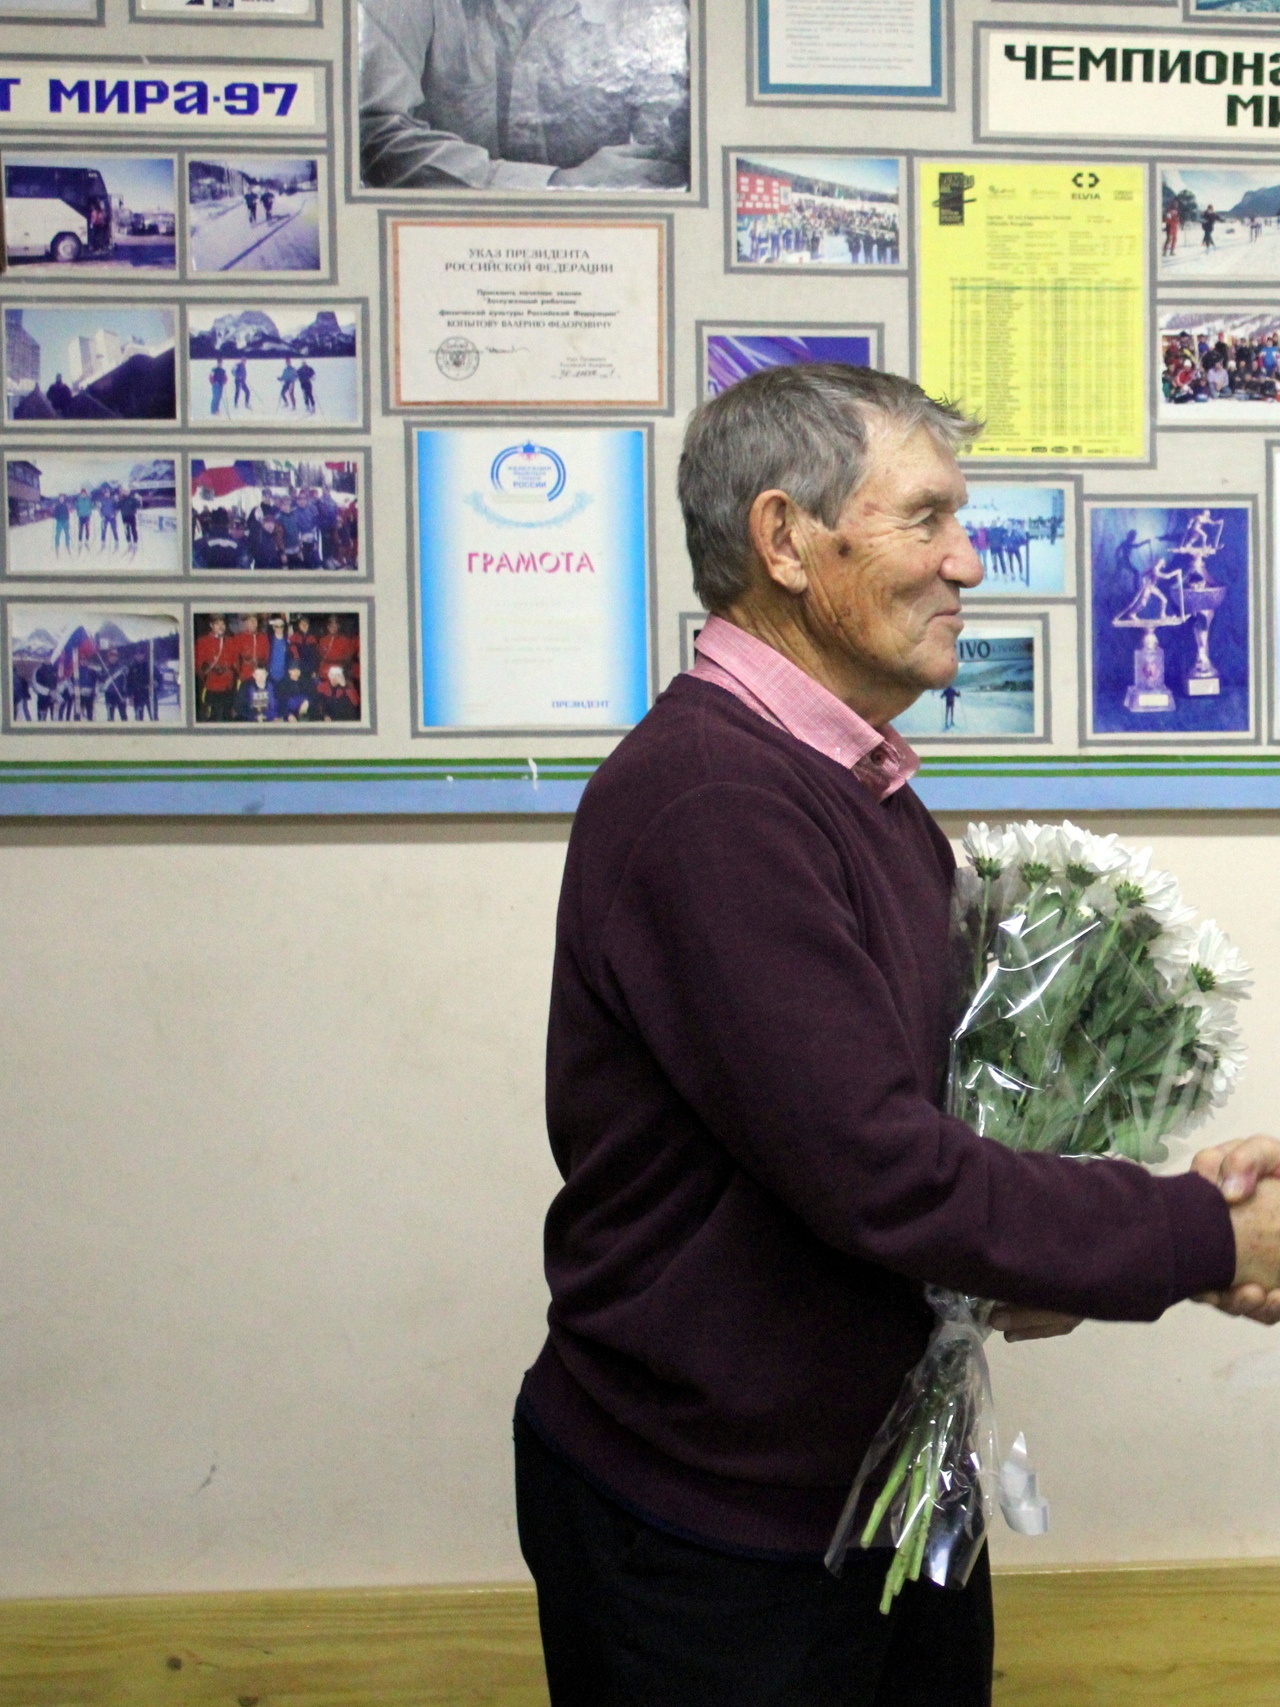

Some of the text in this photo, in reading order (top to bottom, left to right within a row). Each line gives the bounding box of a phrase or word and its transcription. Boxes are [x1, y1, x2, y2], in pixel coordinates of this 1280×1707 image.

[468, 248, 590, 260] УКАЗ ПРЕЗИДЕНТА
[444, 260, 614, 274] РОССИЙСКОЙ ФЕДЕРАЦИИ
[513, 481, 547, 489] РОССИИ
[467, 551, 596, 574] ГРАМОТА
[552, 700, 610, 709] ПРЕЗИДЕНТ
